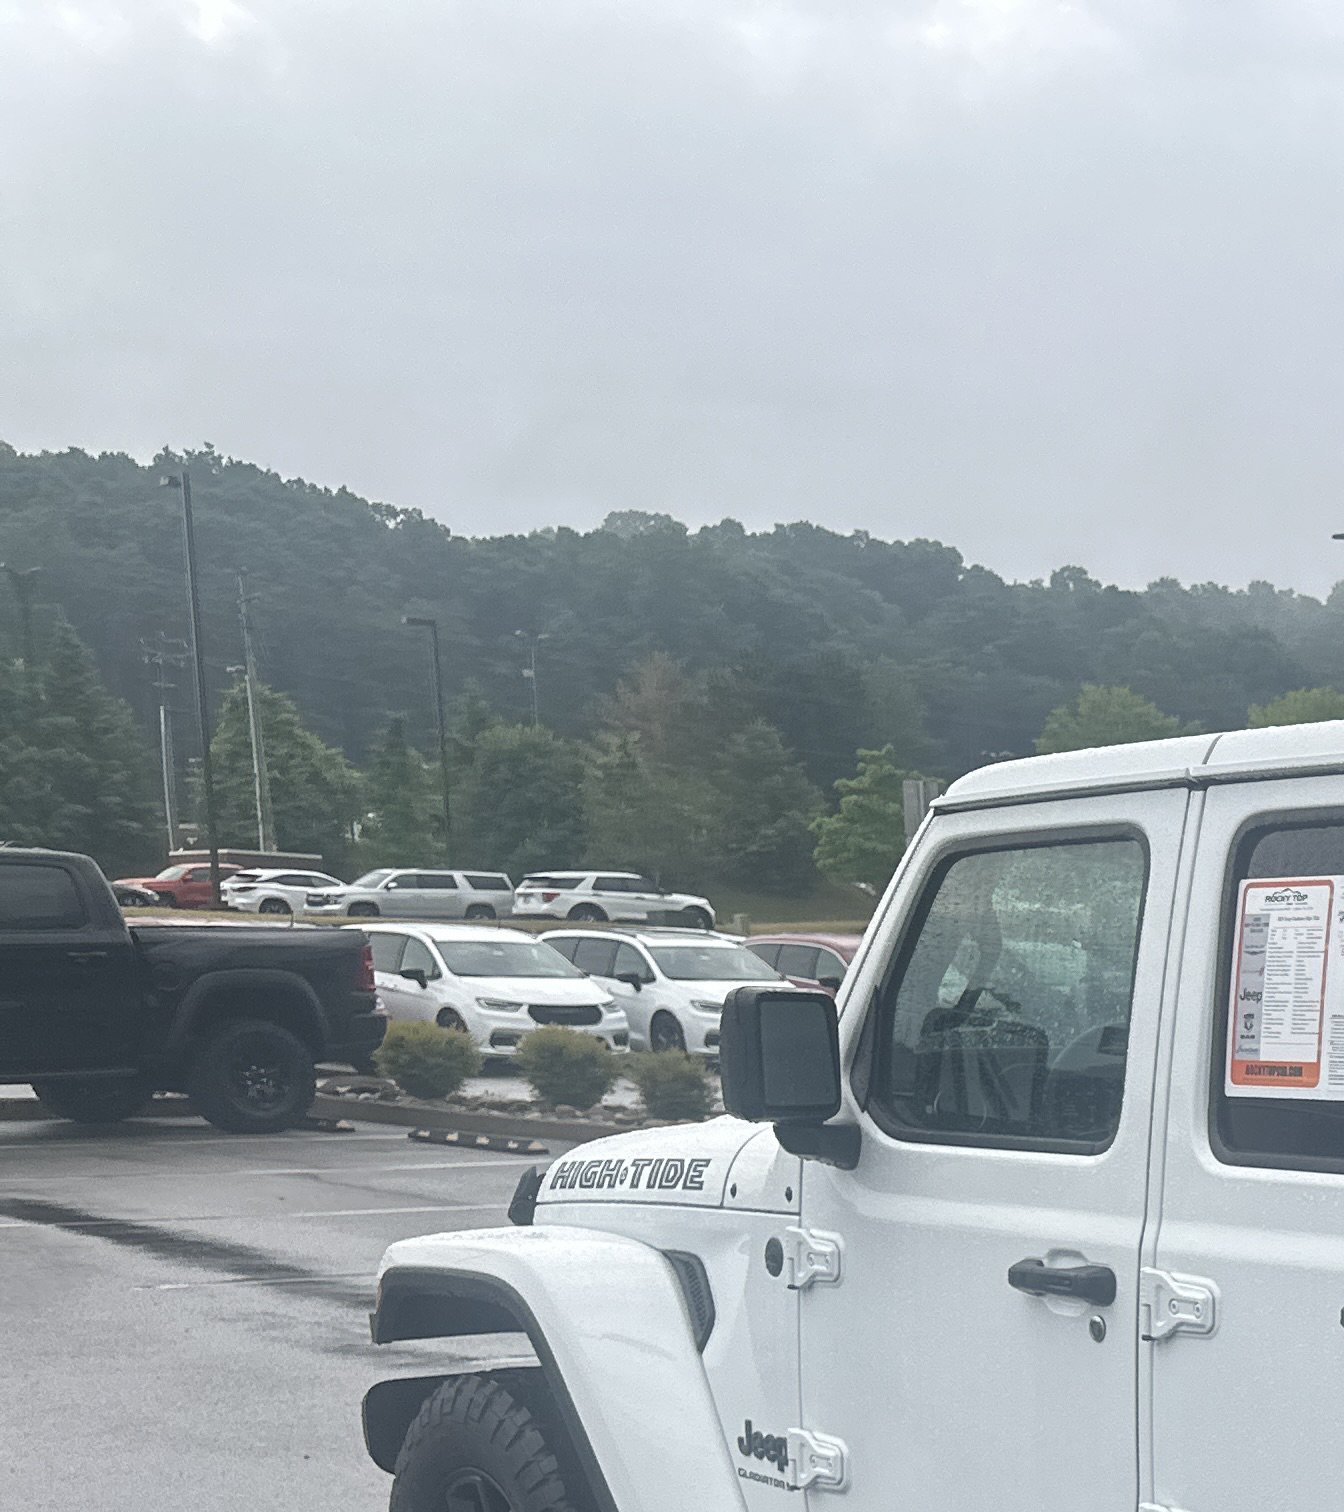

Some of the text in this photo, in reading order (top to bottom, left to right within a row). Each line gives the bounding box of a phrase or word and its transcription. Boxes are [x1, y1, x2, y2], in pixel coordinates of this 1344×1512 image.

[1293, 894, 1308, 902] TOP
[1240, 987, 1262, 1004] Jeep
[737, 1419, 789, 1473] Jeep
